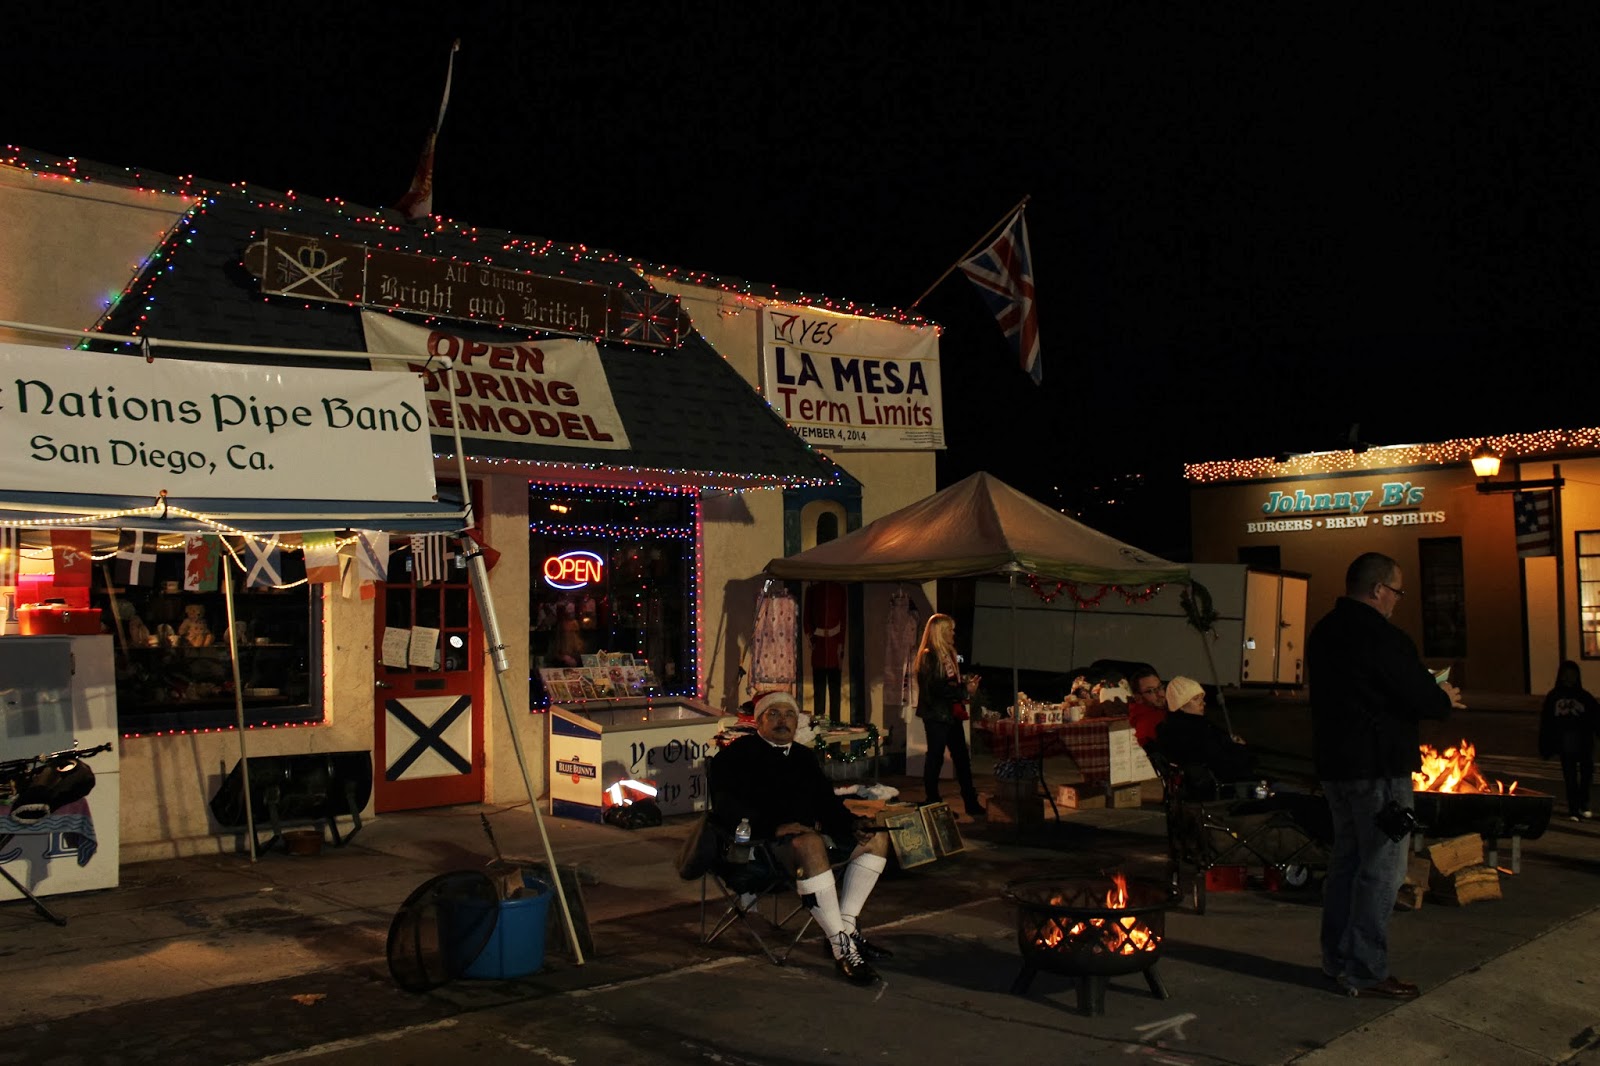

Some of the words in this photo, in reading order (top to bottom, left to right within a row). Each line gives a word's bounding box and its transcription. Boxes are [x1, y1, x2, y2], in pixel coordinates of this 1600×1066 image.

[445, 267, 468, 284] All
[480, 269, 533, 296] Things
[380, 274, 453, 313] Bright
[469, 294, 506, 316] and
[522, 296, 590, 329] British
[800, 319, 838, 345] YES
[427, 331, 545, 374] OPEN
[775, 347, 824, 390] LA
[831, 357, 929, 396] MESA
[15, 379, 202, 425] Nations
[211, 393, 312, 434] Pipe
[321, 397, 422, 432] Band
[428, 399, 614, 442] EMODEL
[777, 387, 851, 424] Term
[857, 395, 933, 427] Limits
[847, 430, 867, 441] 2014
[30, 435, 100, 465] San
[109, 439, 217, 475] Diego,
[226, 444, 275, 471] Ca.
[1262, 488, 1374, 514] Johnny
[1378, 481, 1426, 507] B's
[1247, 519, 1313, 534] BURGERS
[1325, 516, 1369, 530] BREW
[1382, 511, 1446, 527] SPIRITS
[543, 556, 602, 584] OPEN
[558, 762, 573, 774] BLUE
[630, 741, 656, 775] Ye
[663, 738, 711, 763] Olde
